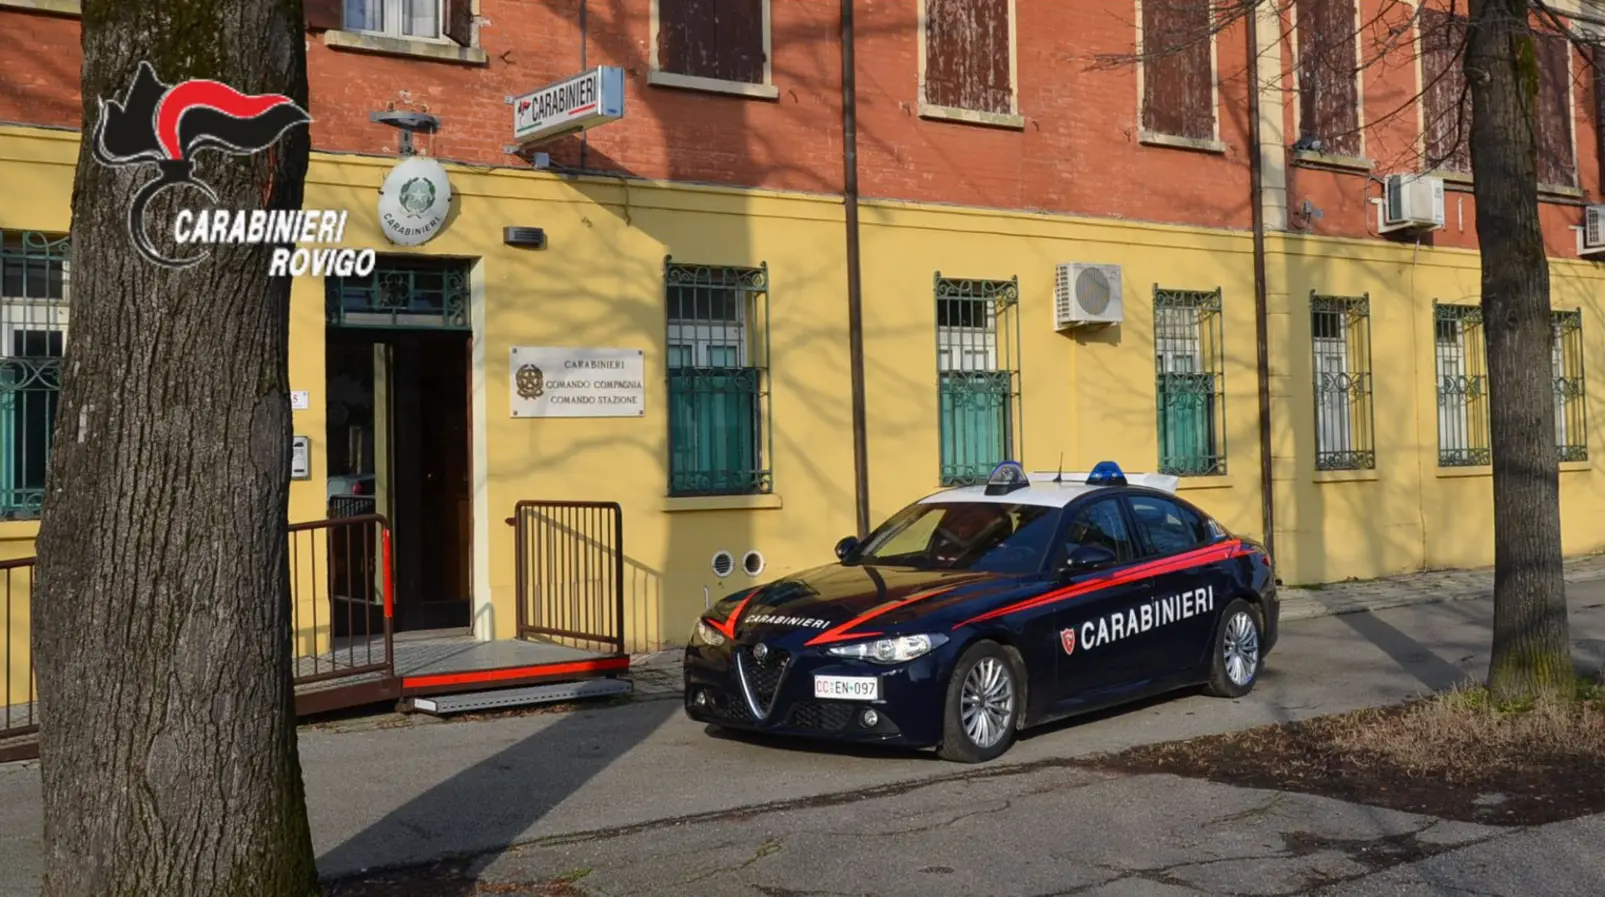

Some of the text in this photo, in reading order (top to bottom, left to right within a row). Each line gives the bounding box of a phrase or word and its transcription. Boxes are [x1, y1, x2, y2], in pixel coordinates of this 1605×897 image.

[531, 76, 596, 122] CARABINIERI
[383, 212, 441, 236] CARABINIERI
[564, 360, 625, 370] CARABINIERI
[545, 380, 642, 390] COMANDO COMPAGNIA
[550, 396, 638, 405] COMANDO STAZIONE
[745, 614, 830, 629] CARABINIERI
[1080, 585, 1215, 651] CARABINIERI
